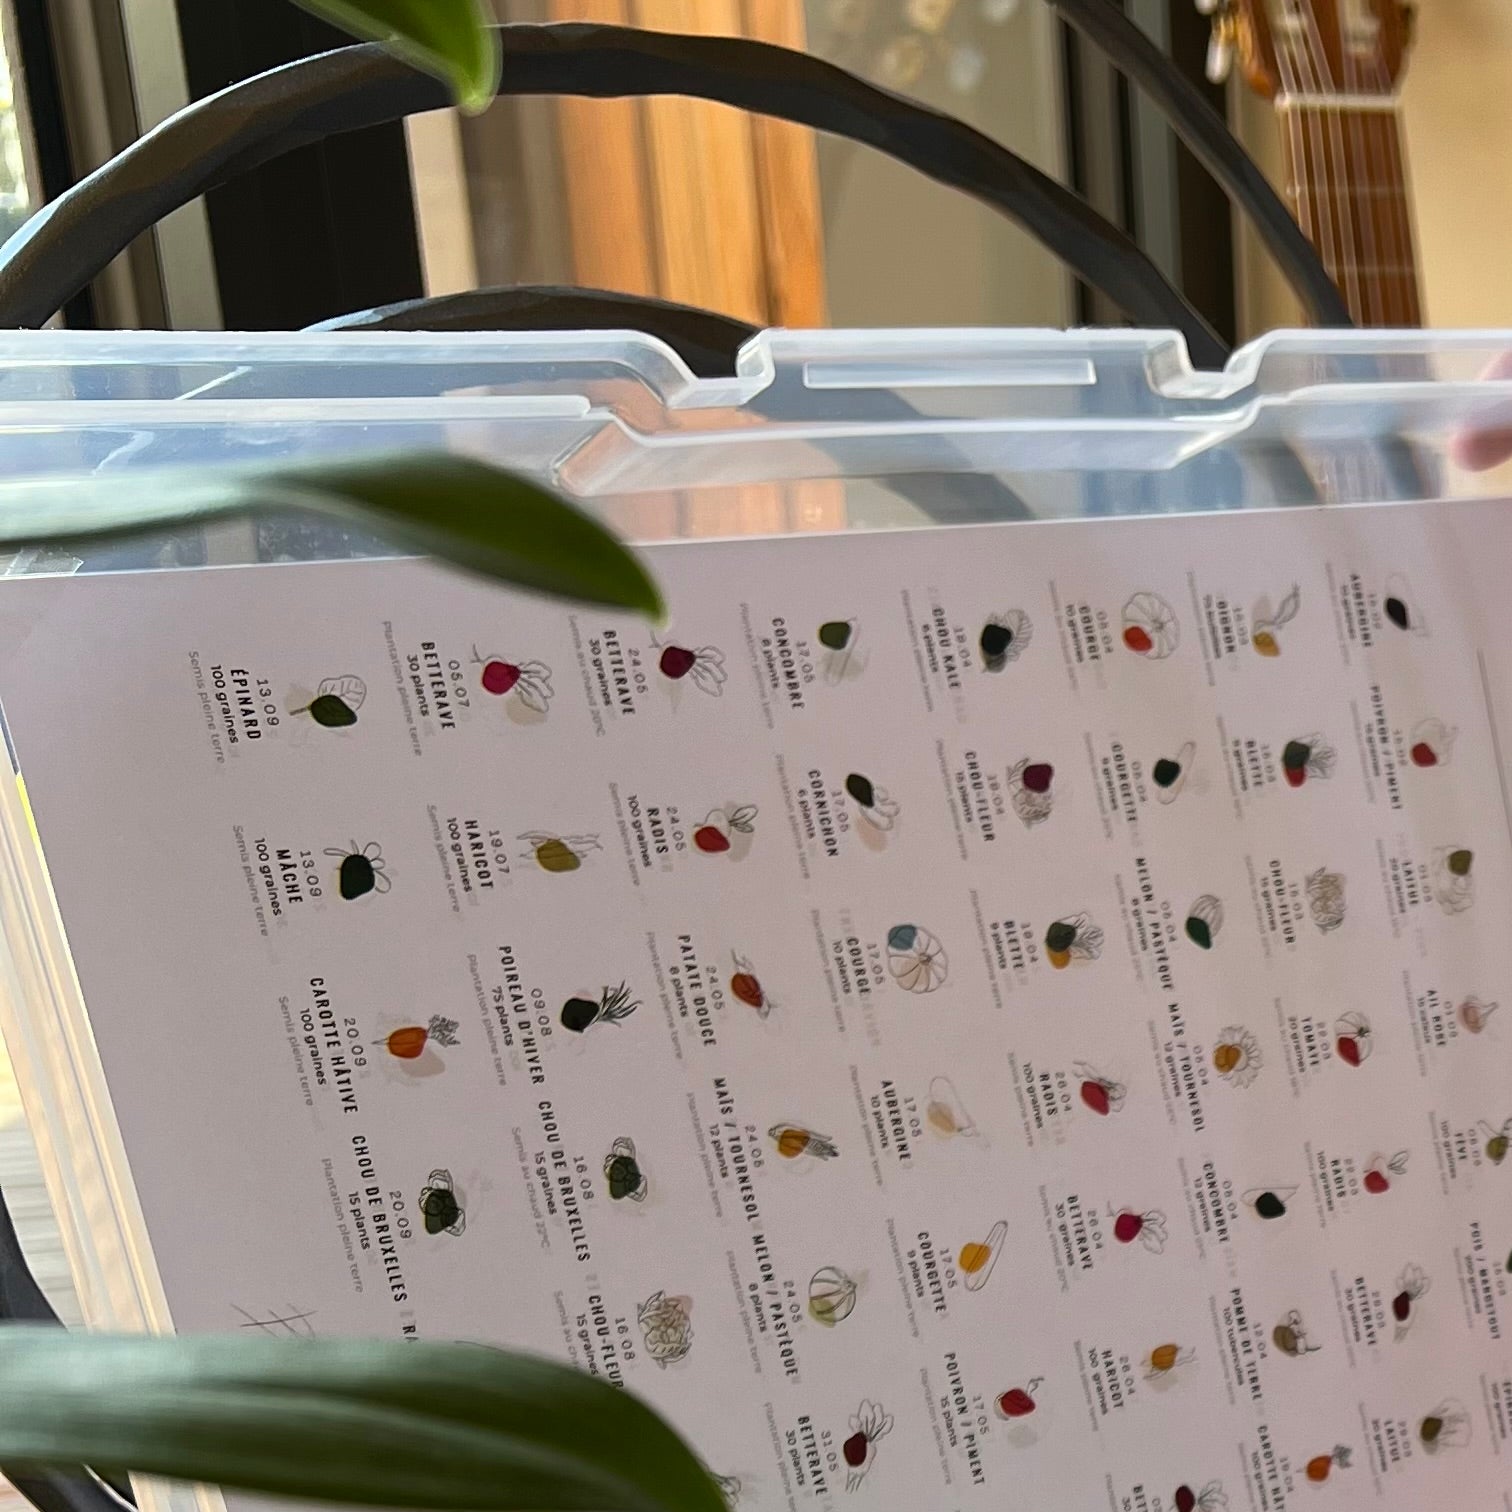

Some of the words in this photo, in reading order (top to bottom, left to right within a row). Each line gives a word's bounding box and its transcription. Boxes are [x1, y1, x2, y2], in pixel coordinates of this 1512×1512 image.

[187, 650, 206, 690] Semis
[209, 664, 227, 690] 100
[406, 654, 421, 673] 30
[420, 641, 456, 729] BETTERAVE
[446, 659, 471, 708] 05.07
[602, 629, 636, 715] BETTERAVE
[771, 617, 805, 709] CONCOMBRE
[196, 691, 218, 731] pleine
[214, 691, 240, 745] graines
[229, 668, 262, 740] ÉPINARD
[255, 678, 281, 727] 13.09
[409, 674, 430, 718] plants
[209, 732, 226, 765] terre
[446, 816, 462, 841] 100
[646, 807, 670, 855] RADIS
[807, 769, 839, 857] CORNICHON
[253, 837, 271, 863] 100
[298, 850, 324, 898] 13.09
[449, 842, 474, 893] graines
[463, 819, 495, 889] HARICOT
[487, 829, 511, 875] 19.07
[258, 864, 283, 917] graines
[275, 848, 304, 904] MÂCHE
[845, 936, 872, 995] COURGE
[277, 995, 296, 1034] Semis
[491, 985, 505, 1004] 75
[498, 945, 528, 1014] POIREAU
[516, 1019, 546, 1085] D'HIVER
[529, 987, 554, 1038] 09.08
[677, 934, 703, 990] PATATE
[692, 995, 717, 1047] DOUCE
[299, 1007, 316, 1033] 100
[342, 1017, 368, 1068] 20.09
[493, 1004, 515, 1047] plants
[285, 1035, 306, 1075] pleine
[303, 1034, 328, 1086] graines
[309, 977, 342, 1049] CAROTTE
[330, 1055, 359, 1114] HÂTIVE
[298, 1074, 315, 1107] terre
[537, 1100, 561, 1143] CHOU
[881, 1080, 912, 1161] AUBERGINE
[351, 1134, 376, 1179] CHOU
[534, 1150, 547, 1166] 15
[550, 1149, 568, 1170] DE
[713, 1077, 735, 1116] MAÏS
[727, 1135, 760, 1222] TOURNESOL
[347, 1190, 362, 1206] 15
[364, 1186, 384, 1207] DE
[535, 1165, 558, 1216] graines
[572, 1155, 596, 1201] 16.08
[320, 1157, 346, 1222] Plantation
[335, 1222, 356, 1262] pleine
[348, 1261, 364, 1294] terre
[349, 1207, 371, 1251] plants
[388, 1189, 413, 1240] 20.09
[556, 1175, 592, 1262] BRUXELLES
[371, 1212, 408, 1303] BRUXELLES
[916, 1231, 948, 1313] COURGETTE
[575, 1312, 589, 1328] 15
[751, 1233, 775, 1283] MELON
[768, 1301, 799, 1377] PASTÈQUE
[576, 1328, 599, 1376] graines
[613, 1316, 637, 1362] 16.08
[943, 1351, 969, 1416] POIVRON
[962, 1432, 986, 1485] PIMENT
[796, 1415, 829, 1496] BETTERAVE
